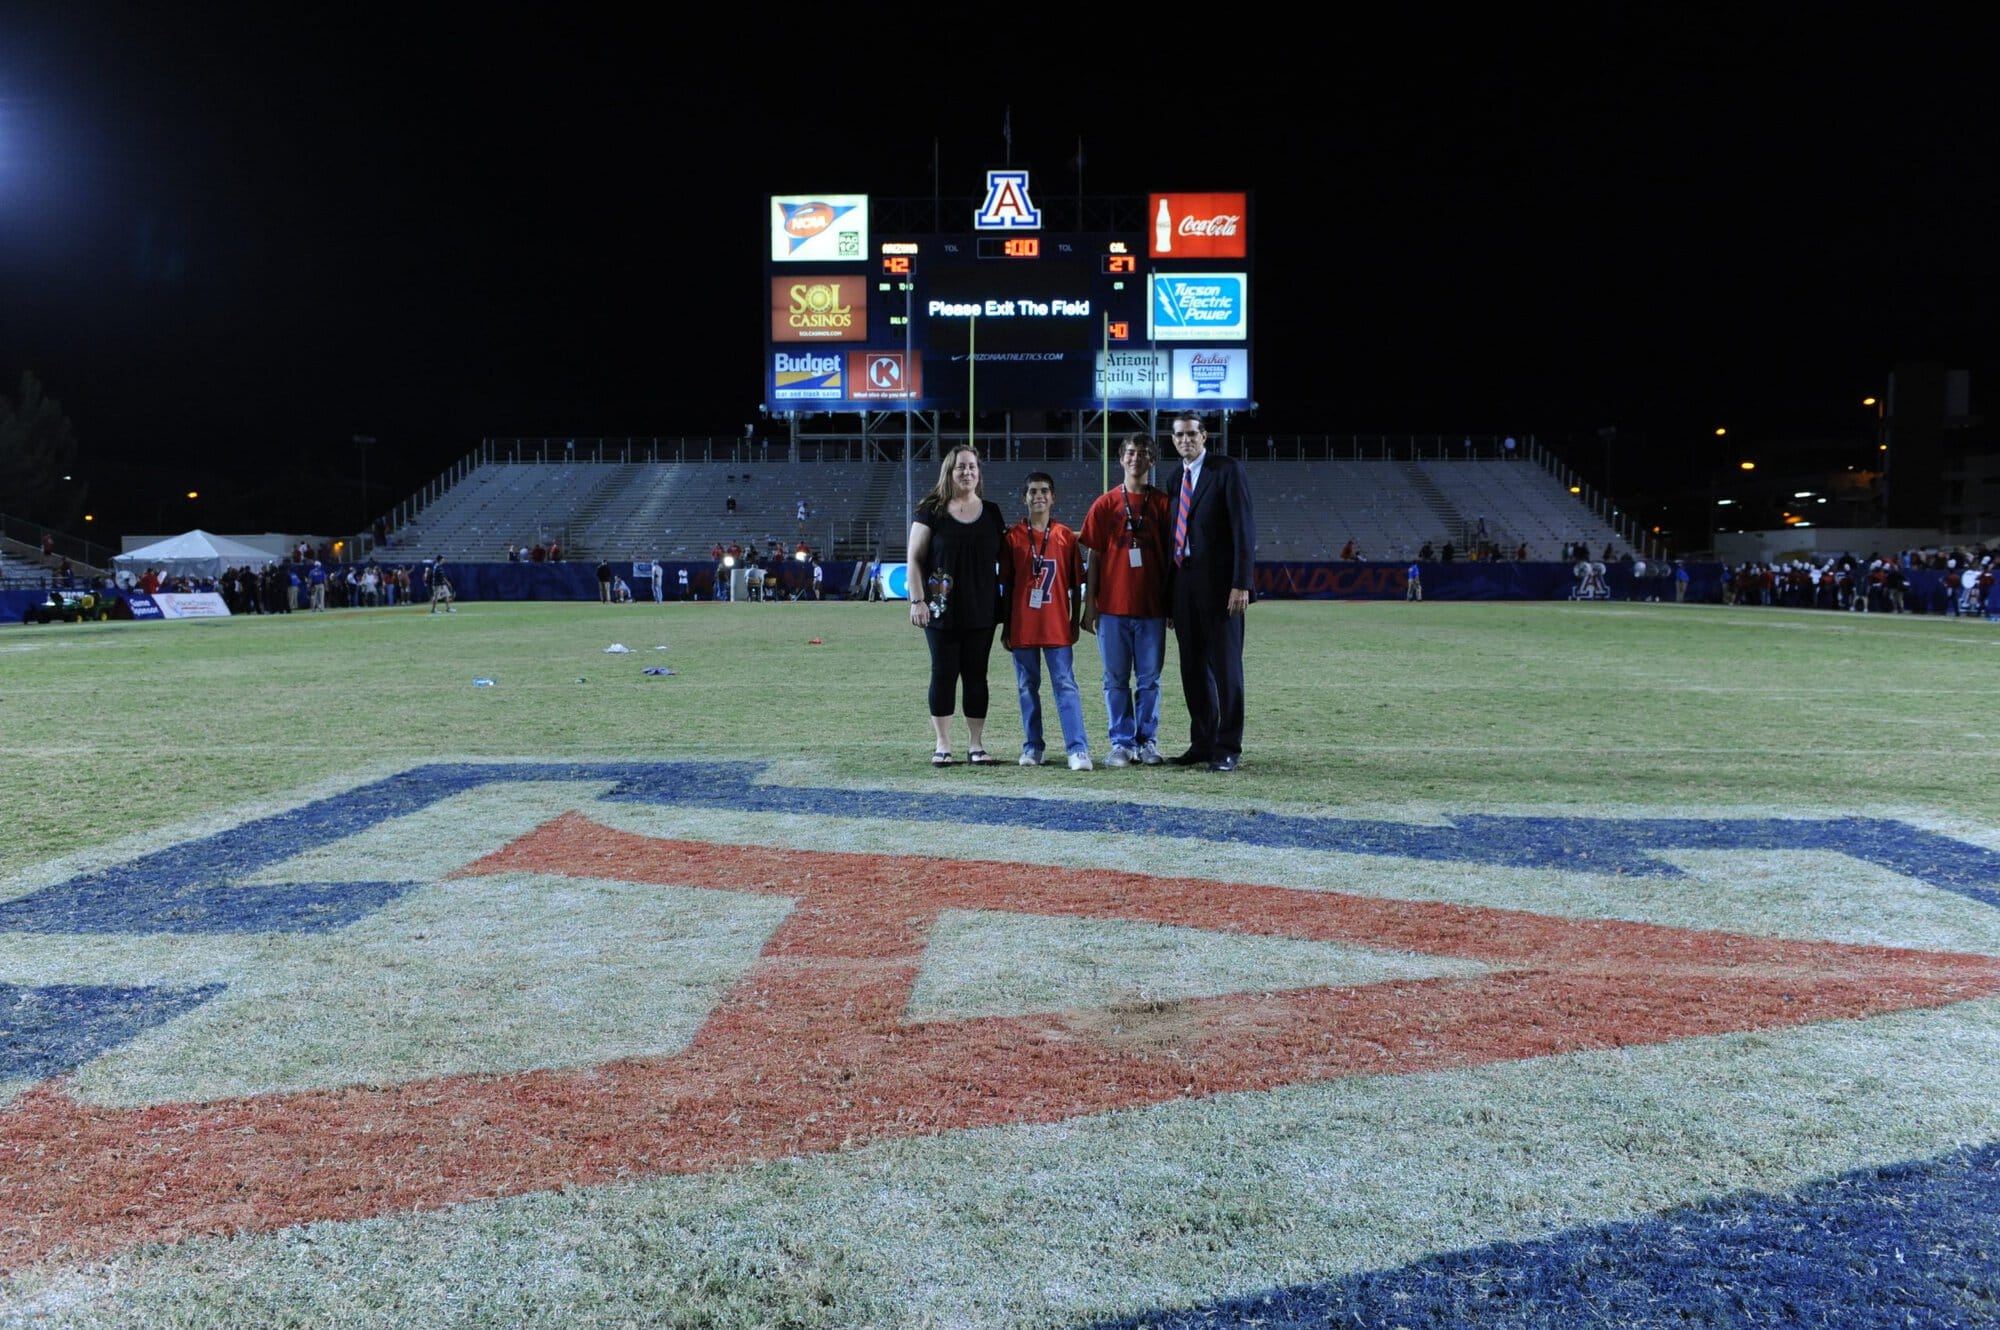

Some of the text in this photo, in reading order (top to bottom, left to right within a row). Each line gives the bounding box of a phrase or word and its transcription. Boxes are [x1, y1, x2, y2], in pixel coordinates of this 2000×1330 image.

[975, 170, 1041, 230] A
[1178, 215, 1240, 236] Coca-Cola
[1058, 244, 1072, 252] TOL
[883, 256, 909, 273] 42
[1109, 256, 1135, 272] 27
[1174, 283, 1221, 297] Tucson
[789, 284, 851, 314] SOL
[1179, 296, 1233, 309] Electric
[928, 300, 1089, 316] Please Exit The Field
[1184, 308, 1233, 321] Power
[789, 314, 852, 327] CASINOS
[1109, 324, 1128, 339] 40
[775, 353, 841, 377] Budget
[1106, 353, 1159, 366] Arizona
[870, 357, 900, 388] K
[1096, 368, 1167, 385] Daily Star
[1032, 559, 1057, 604] 7
